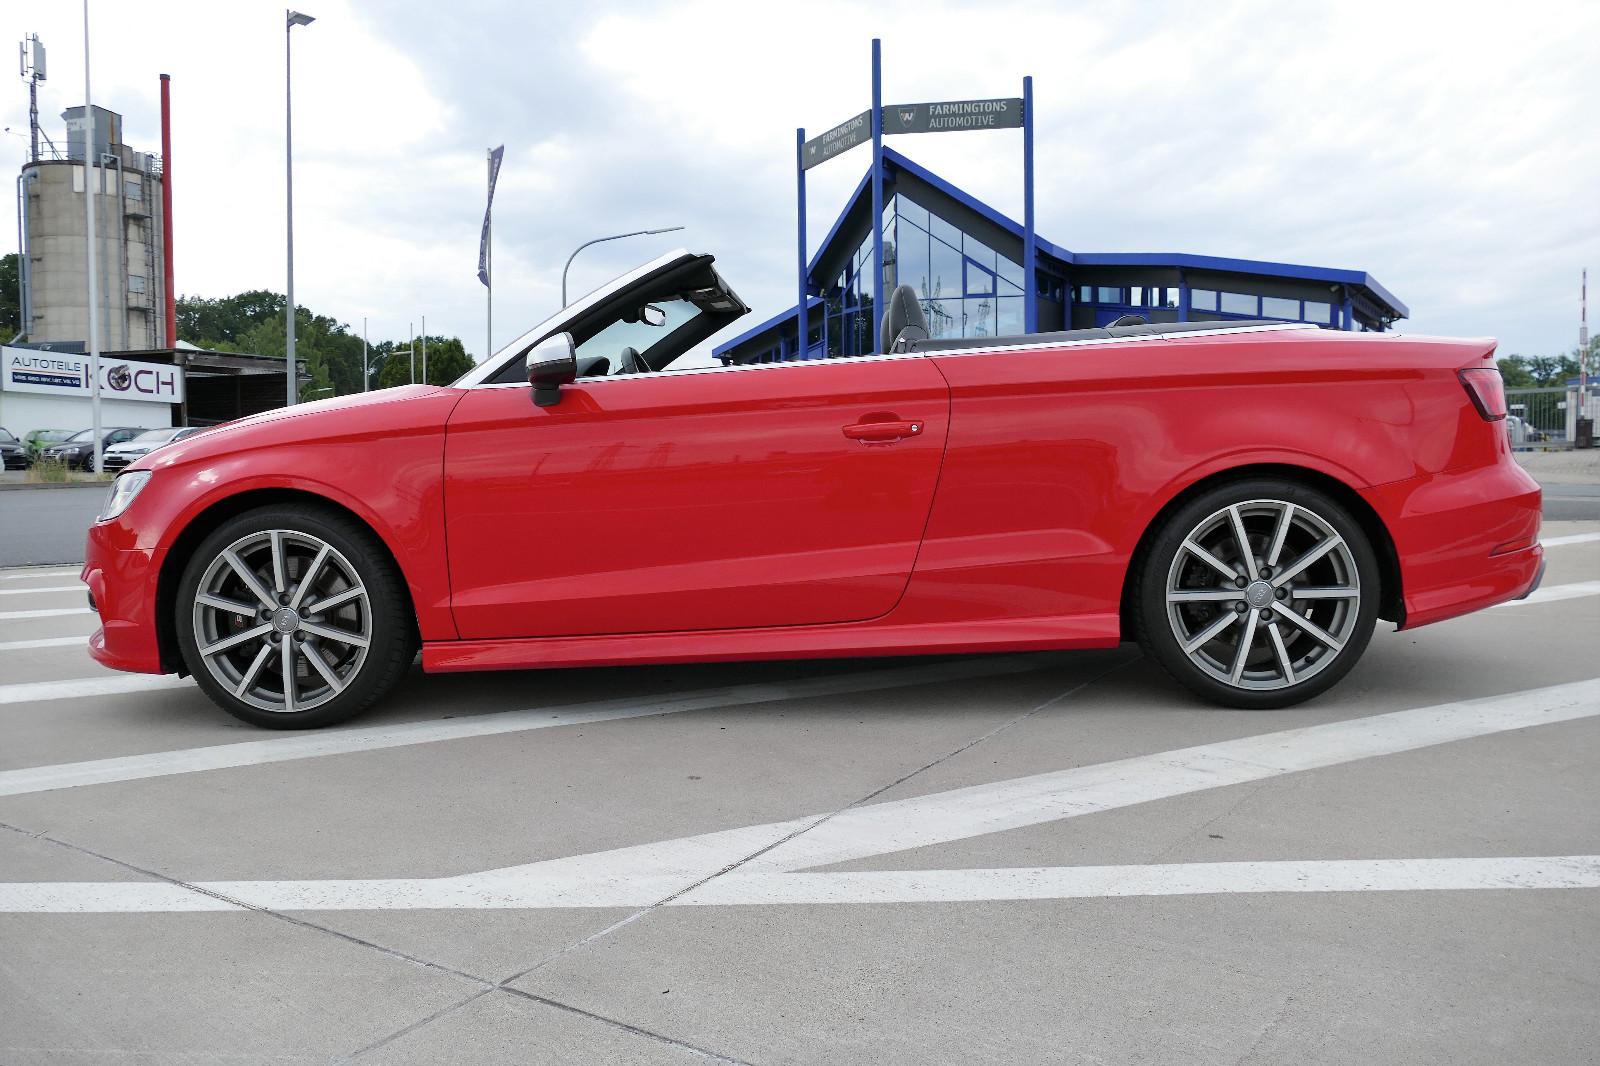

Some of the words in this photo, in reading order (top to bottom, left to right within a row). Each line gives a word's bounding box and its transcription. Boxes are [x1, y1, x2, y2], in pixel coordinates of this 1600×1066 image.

[928, 101, 1008, 116] FARMINGTONS
[928, 114, 995, 129] AUTOMOTIVE
[12, 356, 81, 372] AUTOTEILE
[84, 363, 175, 396] KOCH
